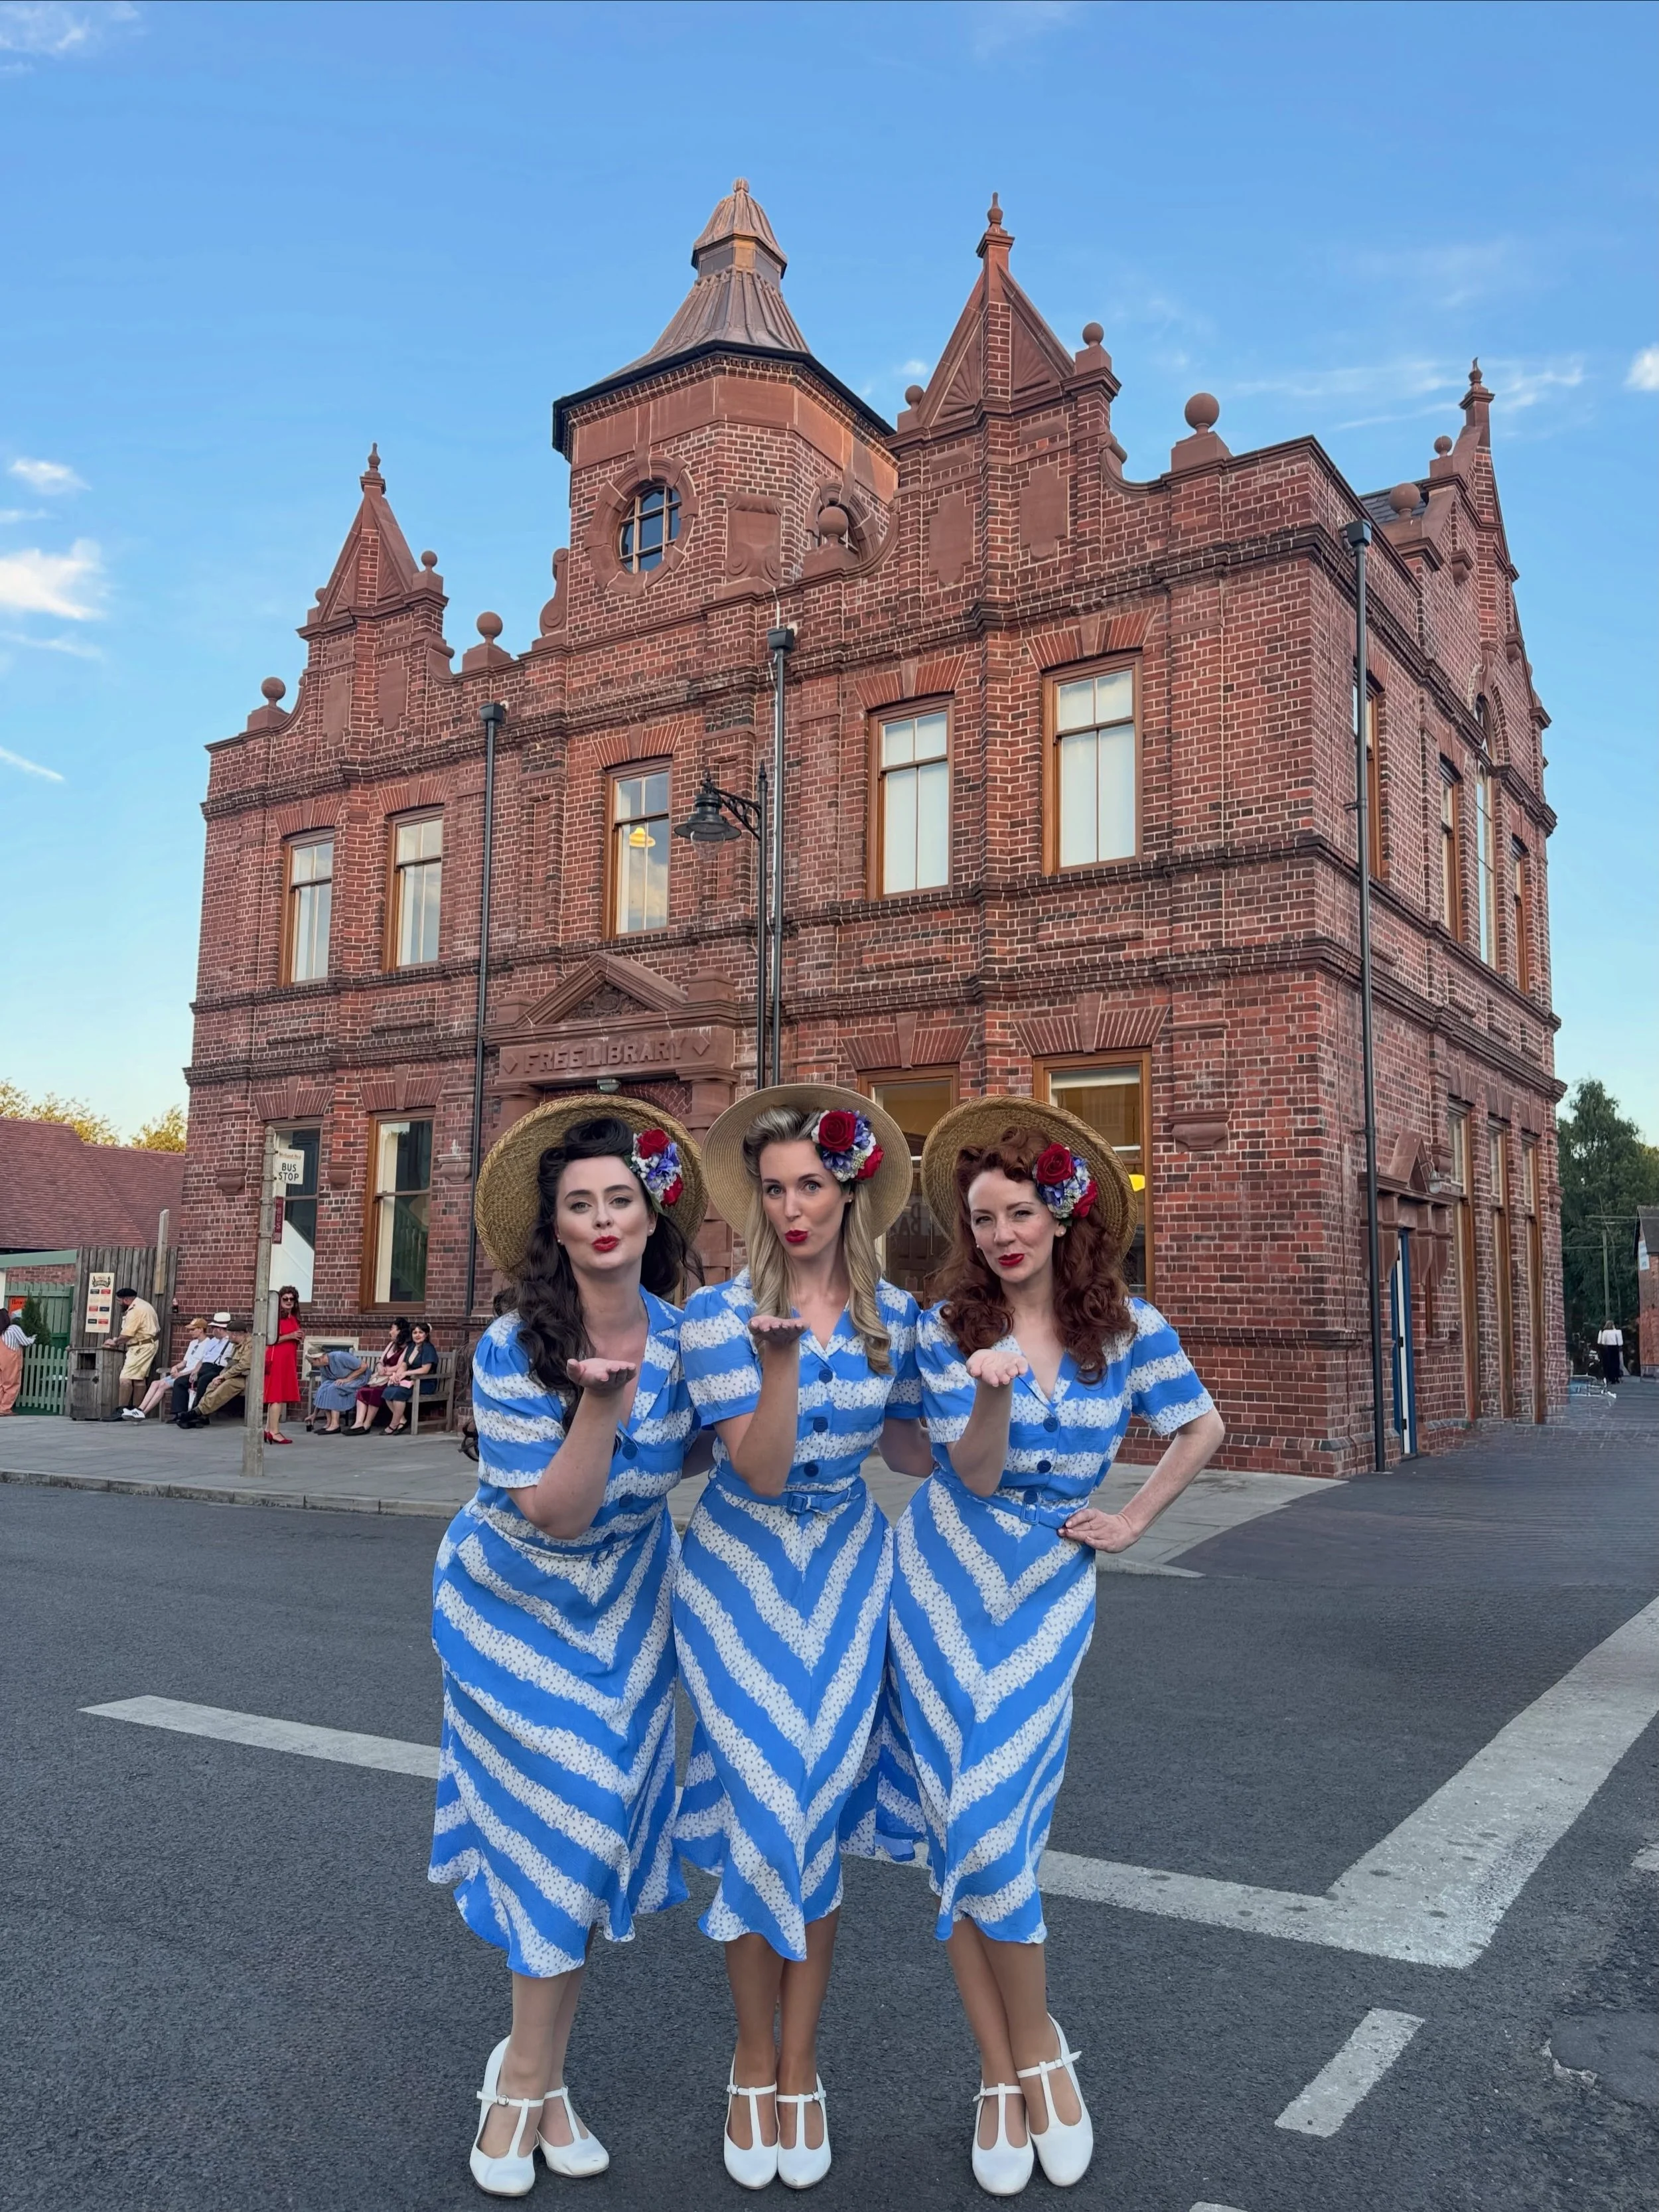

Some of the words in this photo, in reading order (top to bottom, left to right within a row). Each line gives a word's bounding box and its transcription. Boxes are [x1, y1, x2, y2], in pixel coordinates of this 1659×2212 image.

[524, 1049, 584, 1073] FREE
[585, 1038, 685, 1068] LIBRARY
[281, 1162, 297, 1172] BUS
[278, 1171, 299, 1181] STOP
